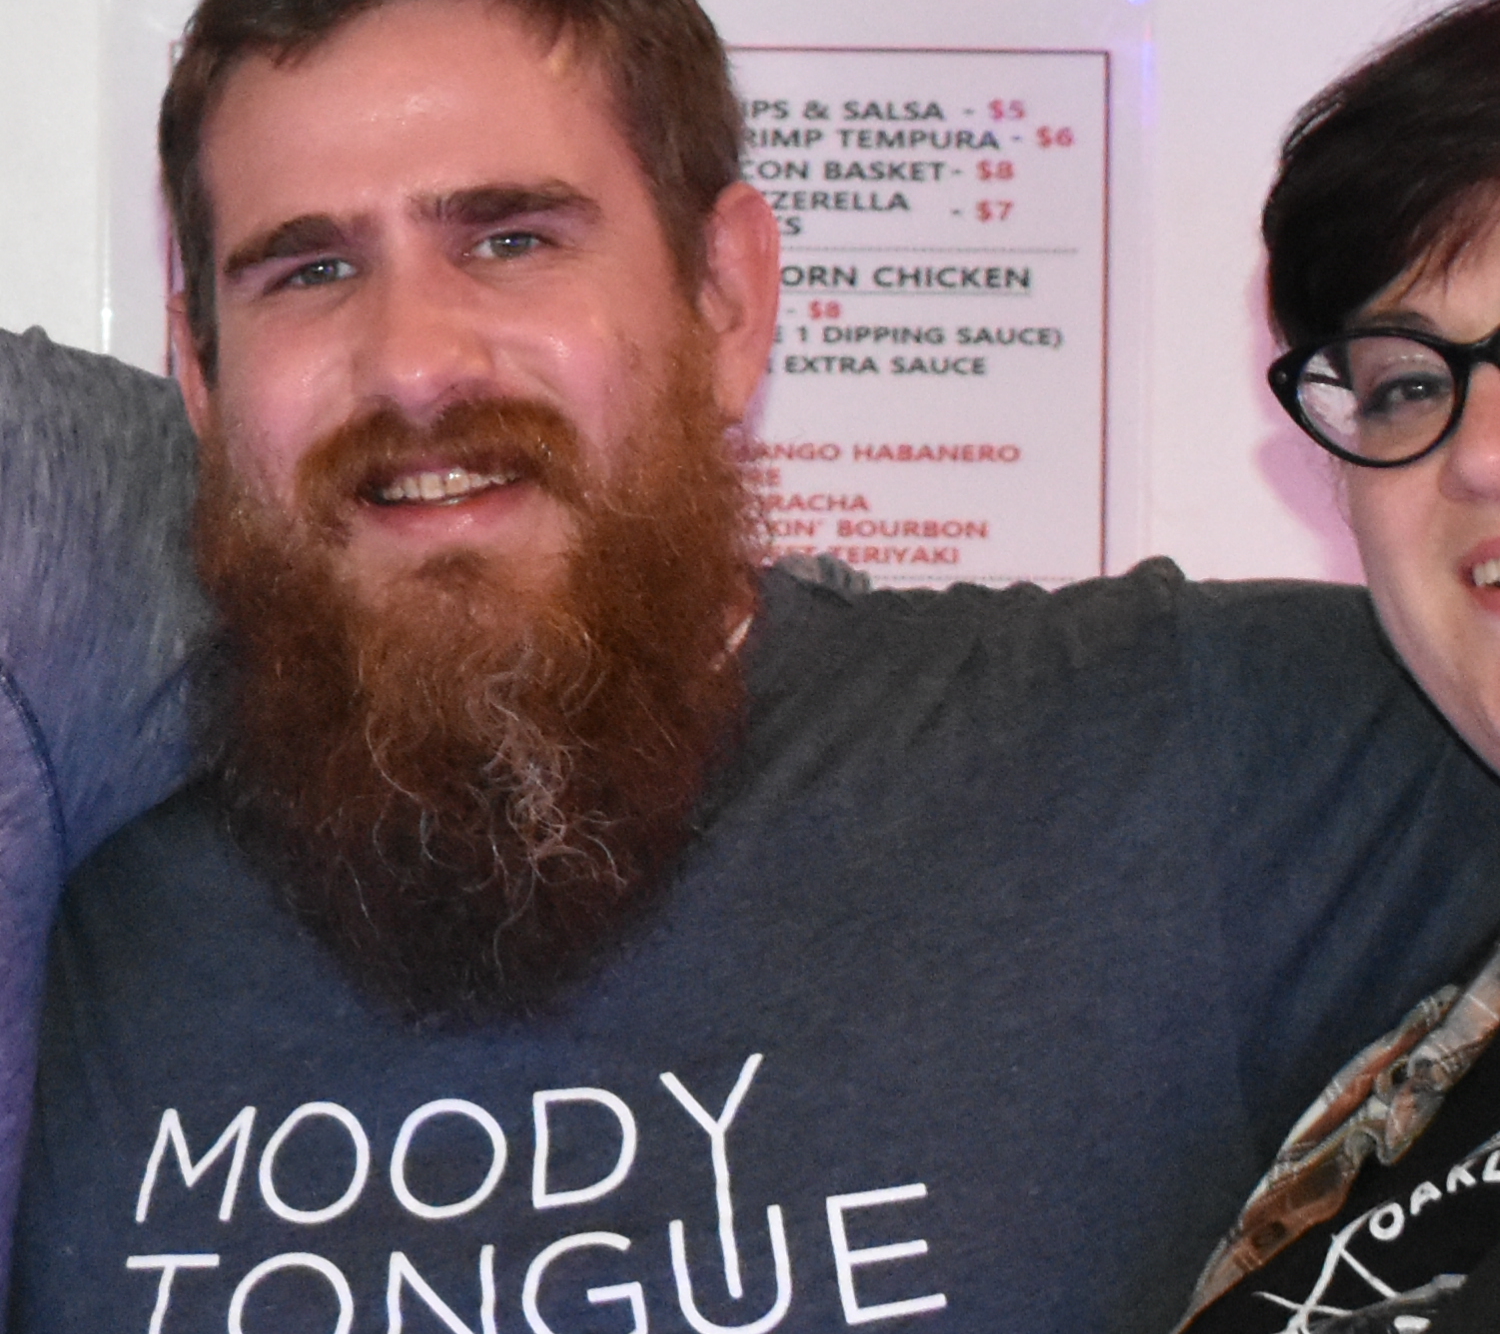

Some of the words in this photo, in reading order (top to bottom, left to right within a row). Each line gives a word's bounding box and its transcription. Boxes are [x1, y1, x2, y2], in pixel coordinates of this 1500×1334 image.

[802, 100, 830, 121] &
[843, 99, 945, 121] SALSA
[987, 98, 1026, 122] $5
[836, 128, 1001, 151] TEMPURA
[1035, 125, 1075, 149] $6
[824, 160, 946, 182] BASKET
[975, 159, 1014, 181] $8
[975, 199, 1014, 223] $7
[872, 266, 1031, 289] CHICKEN
[807, 299, 842, 320] $8
[822, 326, 945, 346] DIPPING
[956, 326, 1064, 350] SAUCE)
[784, 354, 880, 375] EXTRA
[889, 355, 987, 376] SAUCE
[853, 442, 1022, 464] HABANERO
[836, 520, 989, 540] BOURBON
[829, 545, 960, 565] TERIYAKI
[135, 1053, 764, 1299] MOODY
